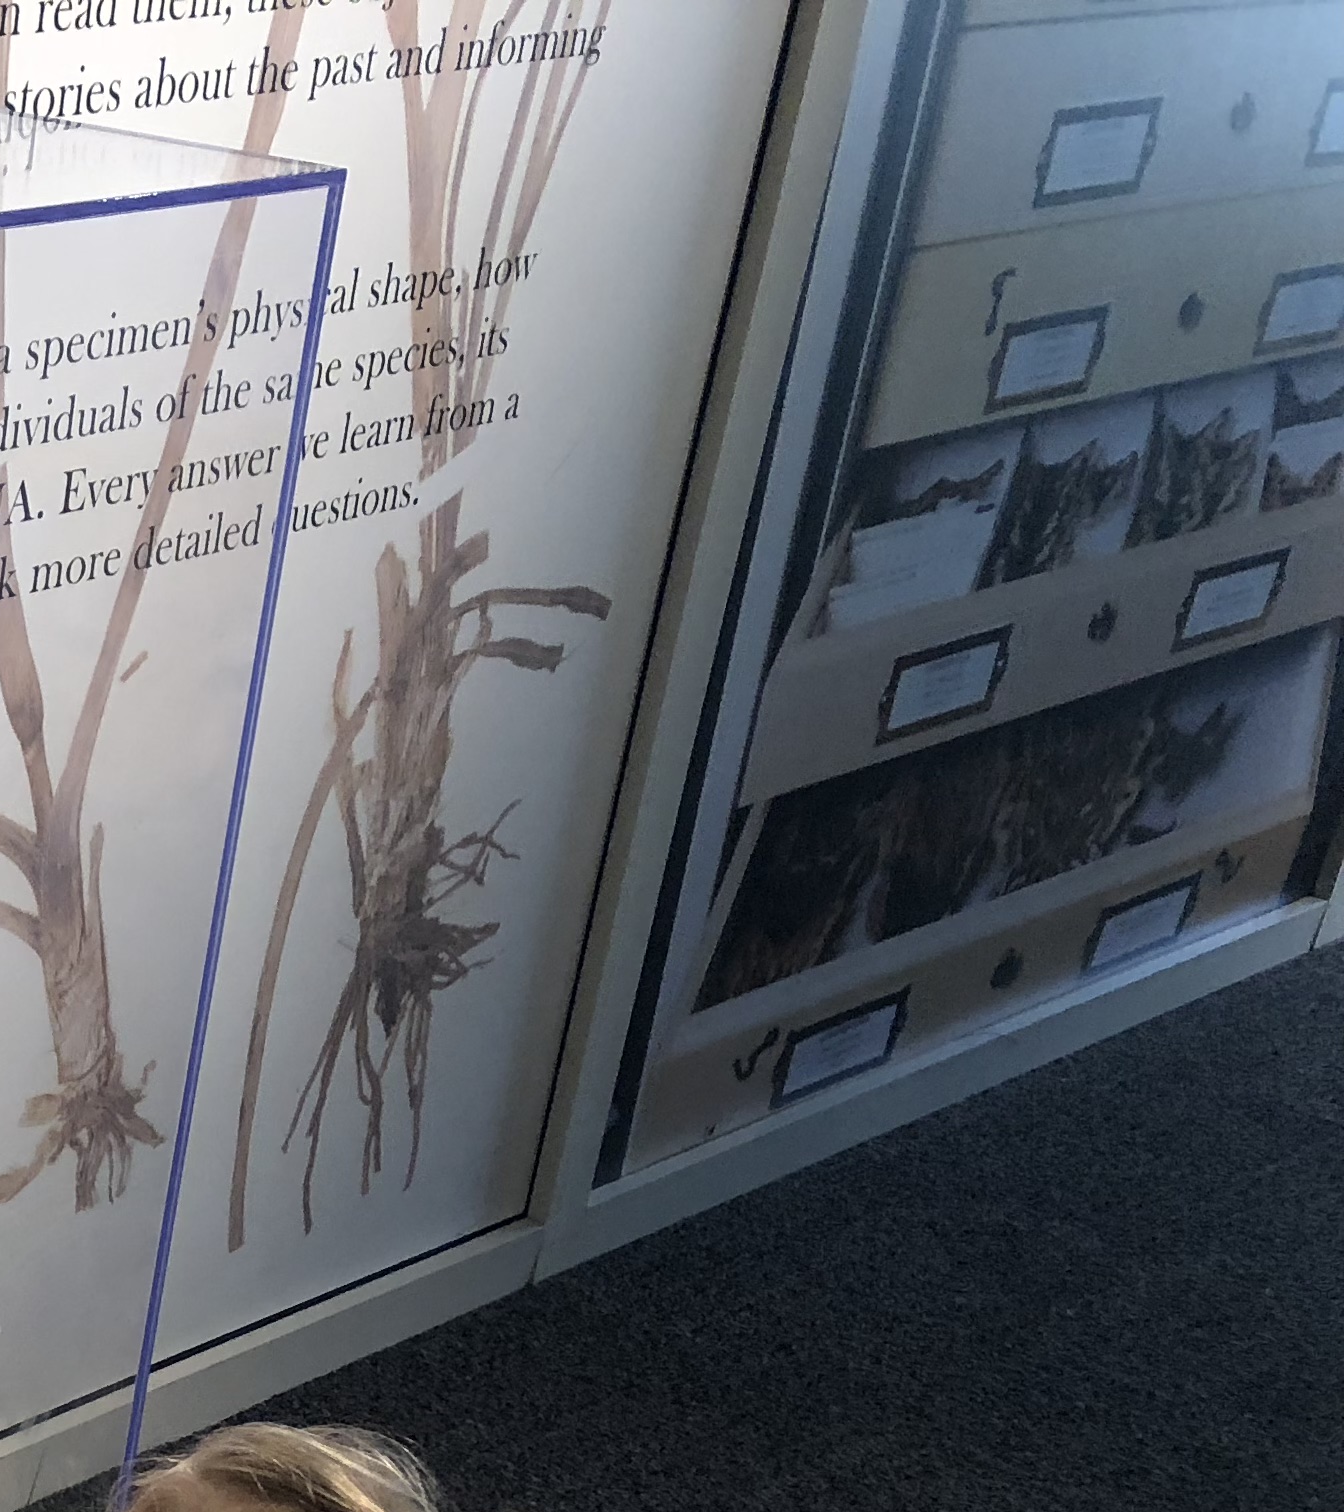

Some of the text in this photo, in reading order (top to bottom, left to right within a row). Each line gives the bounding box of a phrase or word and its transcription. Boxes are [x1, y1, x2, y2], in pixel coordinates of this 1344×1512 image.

[4, 64, 121, 119] stories
[134, 58, 236, 109] about
[248, 47, 297, 95] the
[308, 45, 378, 102] past
[387, 29, 444, 79] and
[454, 13, 607, 71] informing
[36, 0, 117, 35] read
[25, 299, 217, 379] specimen's
[229, 267, 359, 349] physal
[368, 261, 461, 311] shape,
[474, 247, 538, 290] how
[156, 374, 197, 421] of
[200, 369, 250, 418] the
[352, 328, 466, 391] species,
[477, 316, 509, 357] its
[60, 468, 158, 516] Every
[169, 443, 280, 493] answer
[340, 412, 414, 454] learn
[424, 393, 494, 438] from
[505, 392, 520, 419] a
[29, 544, 121, 595] more
[134, 504, 261, 571] detailed
[271, 478, 420, 536] uestions.
